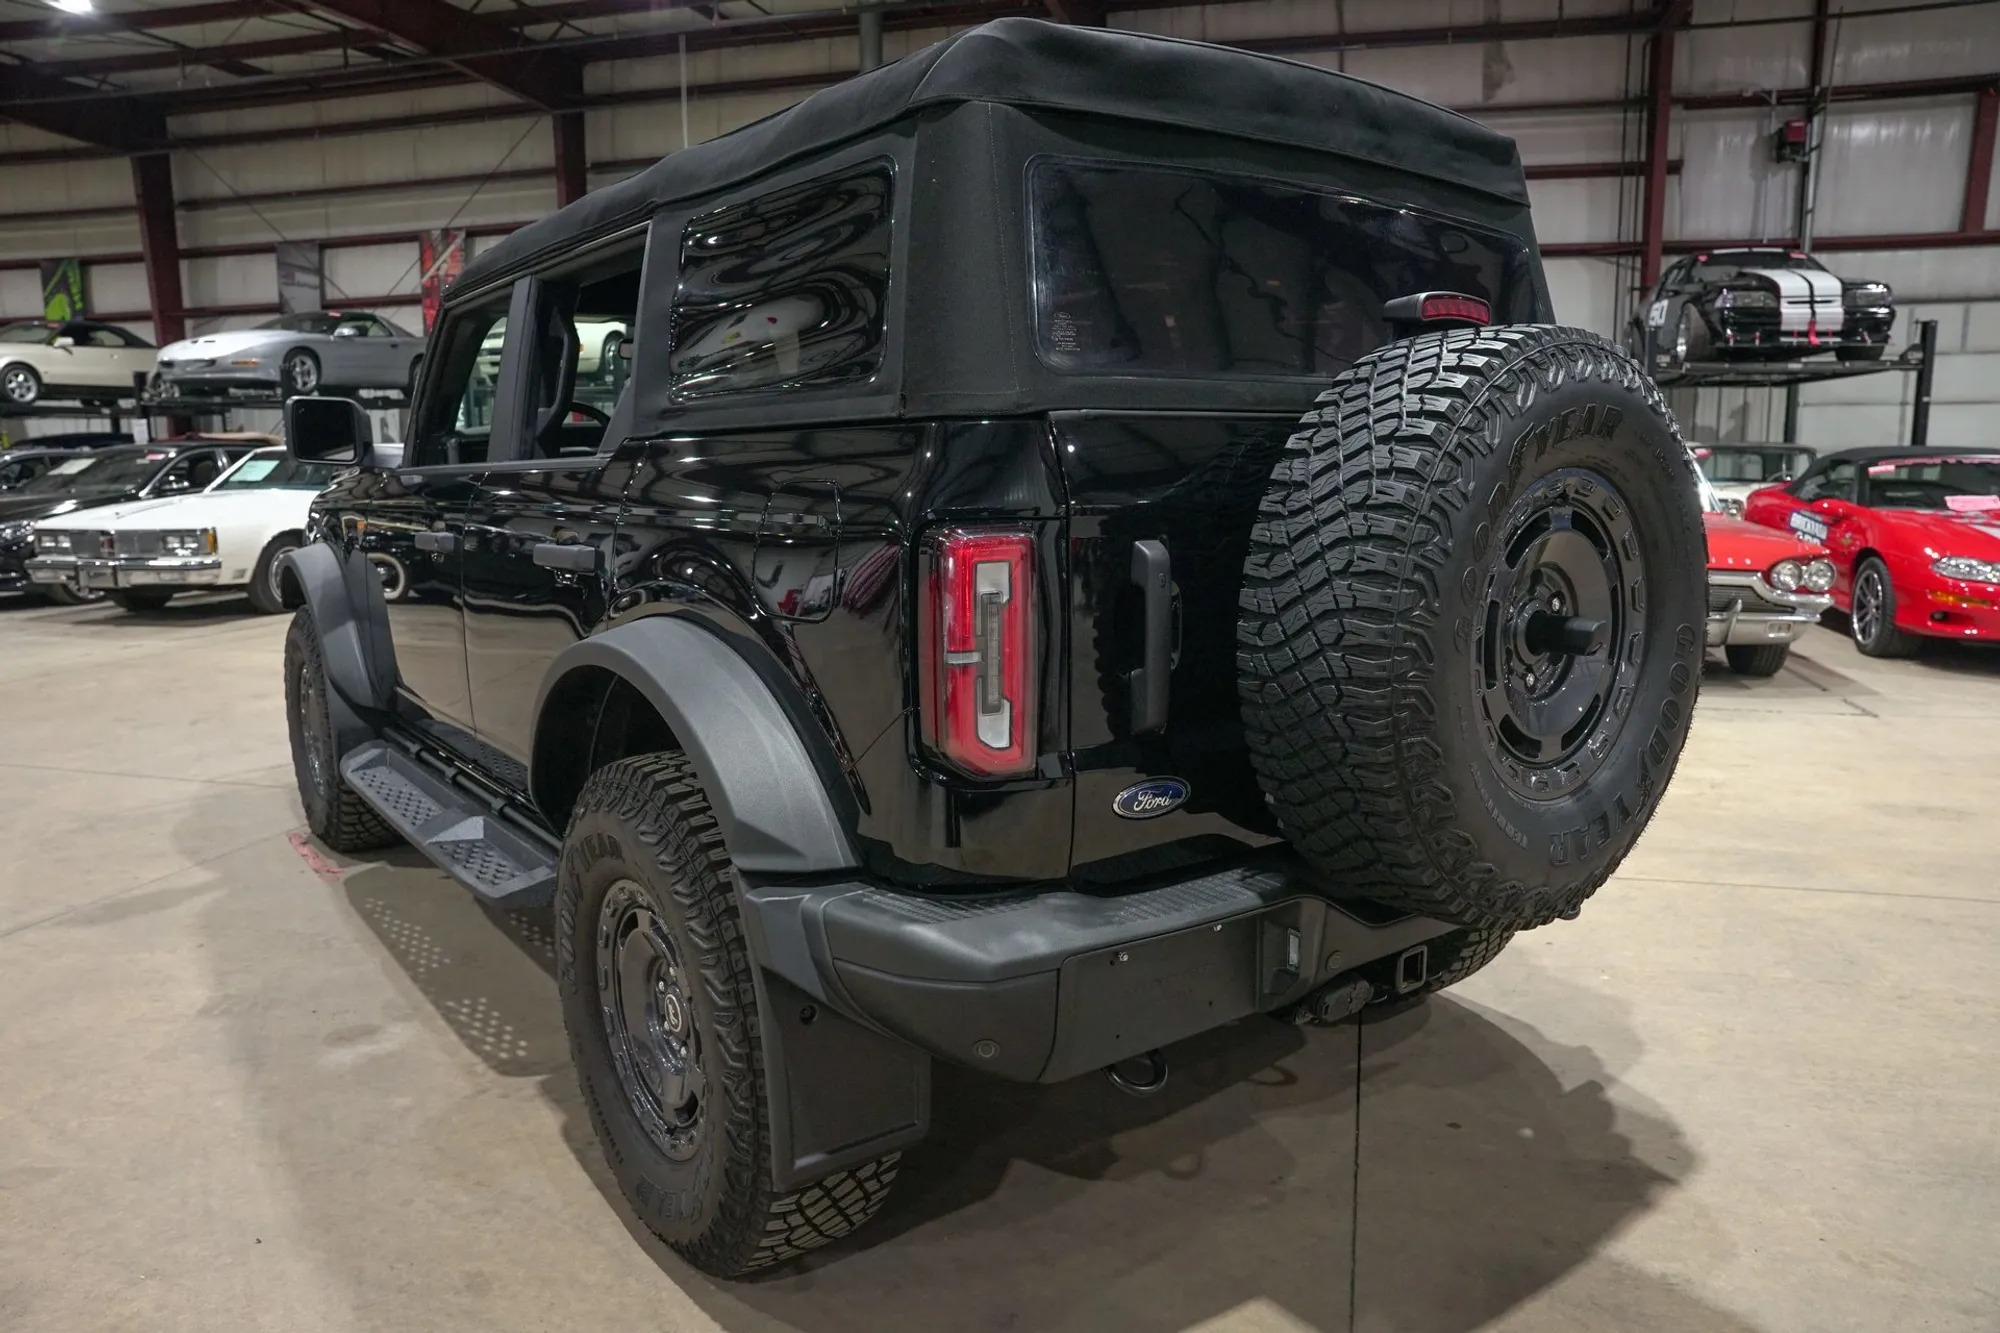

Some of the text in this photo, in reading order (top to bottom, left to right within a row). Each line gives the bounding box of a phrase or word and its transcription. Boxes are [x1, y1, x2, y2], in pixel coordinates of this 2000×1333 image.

[1453, 403, 1624, 654] GOODYEAR
[1133, 788, 1173, 812] Ford
[1549, 622, 1697, 867] GOODYEAR
